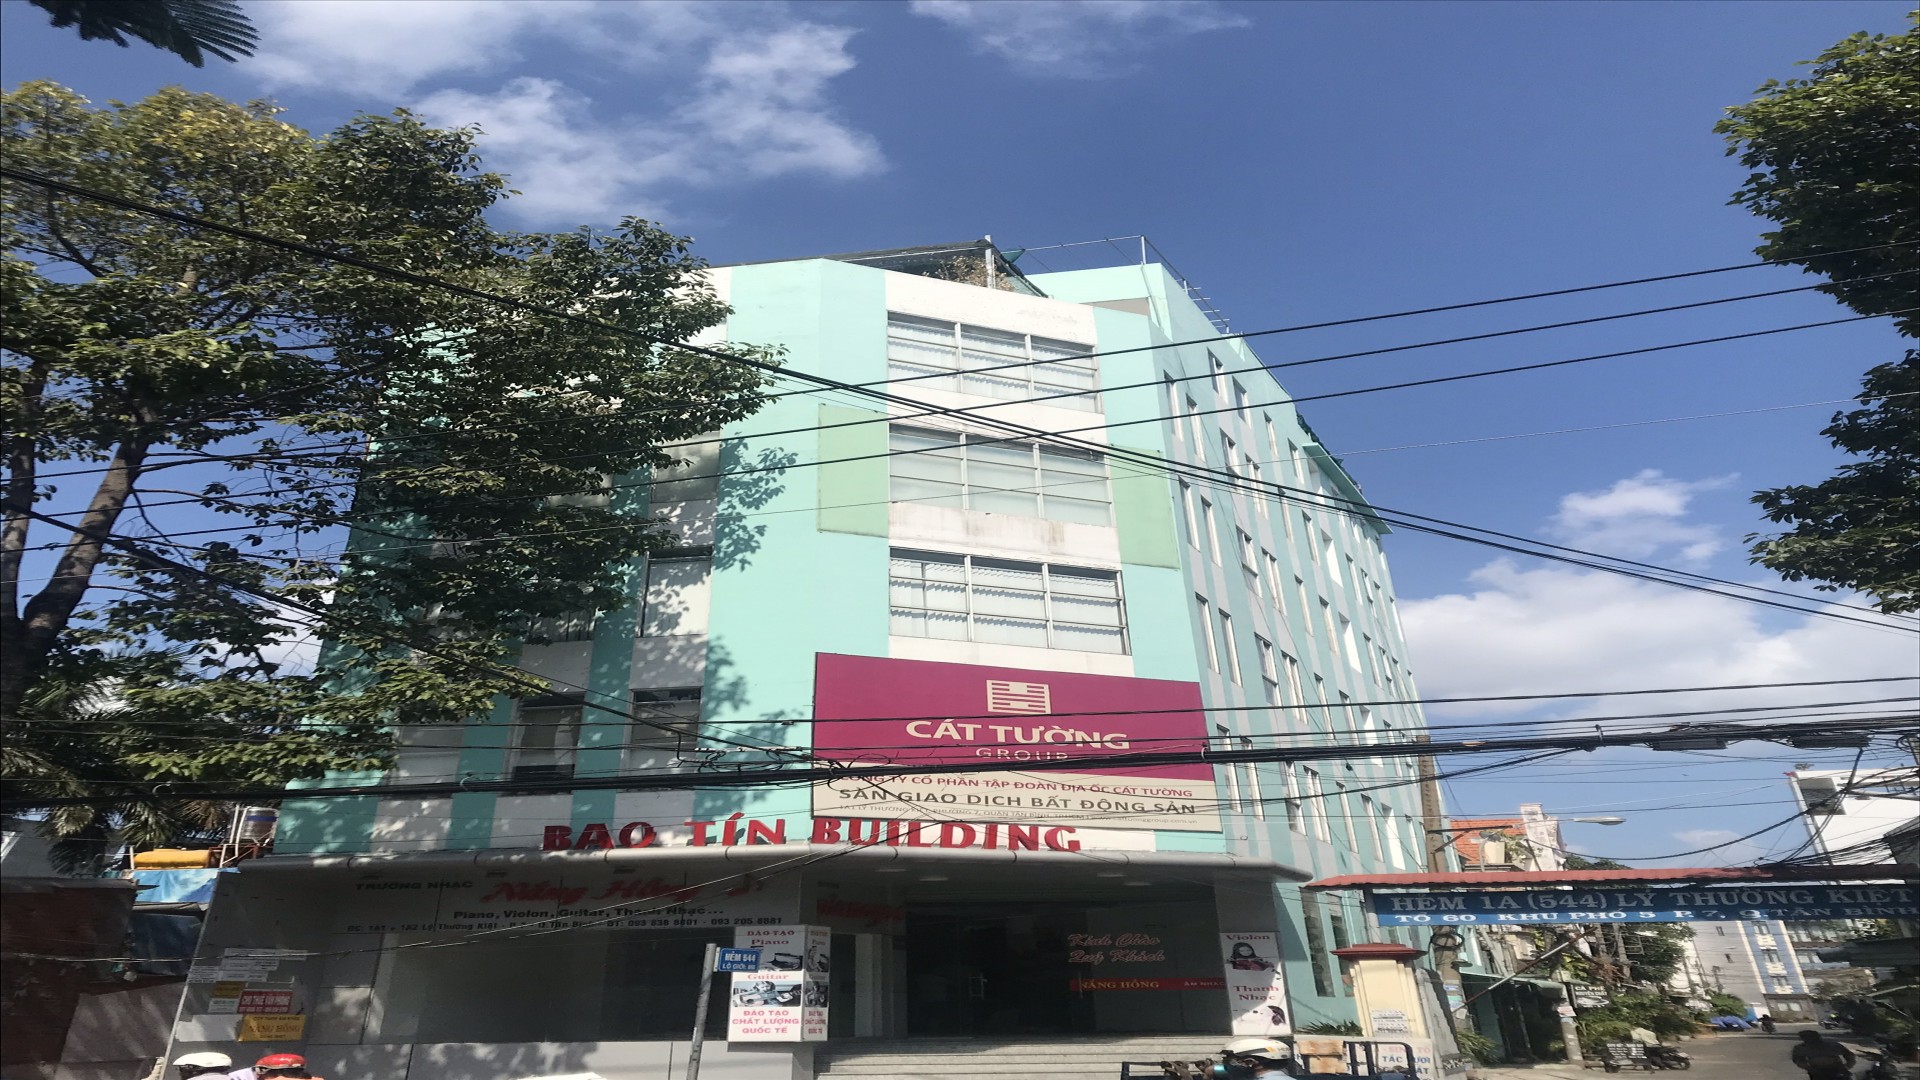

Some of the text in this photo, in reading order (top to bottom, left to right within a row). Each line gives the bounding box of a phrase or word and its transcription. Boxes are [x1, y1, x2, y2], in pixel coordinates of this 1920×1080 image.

[906, 719, 1131, 750] CÁT TƯỜNG
[976, 748, 1069, 761] GROUP
[890, 776, 907, 784] TY
[937, 777, 980, 788] PHẦN
[983, 780, 1011, 789] TẬP
[1013, 781, 1057, 791] ĐOÀN
[1113, 785, 1138, 796] CÁT
[1143, 787, 1193, 798] TƯỜNG
[840, 787, 1195, 814] SÀN GIAO DỊCH BẤT ĐỘNG SẢN
[684, 812, 786, 847] TÍN
[812, 818, 1081, 852] BUILDING
[1390, 886, 1912, 911] HẺM 1A (544) LÝ THƯỜNG KIỆT
[454, 911, 500, 922] Piano,
[503, 910, 555, 919] Violon,
[557, 907, 610, 919] Guitar,
[629, 919, 647, 927] 093
[734, 917, 753, 925] 205
[1443, 914, 1477, 922] 60
[1497, 912, 1558, 921] KHU
[1568, 908, 1627, 920] PHỐ
[1638, 911, 1656, 919] 5
[1673, 910, 1694, 918] P.
[743, 954, 756, 962] 544
[764, 1018, 799, 1026] LƯỢNG
